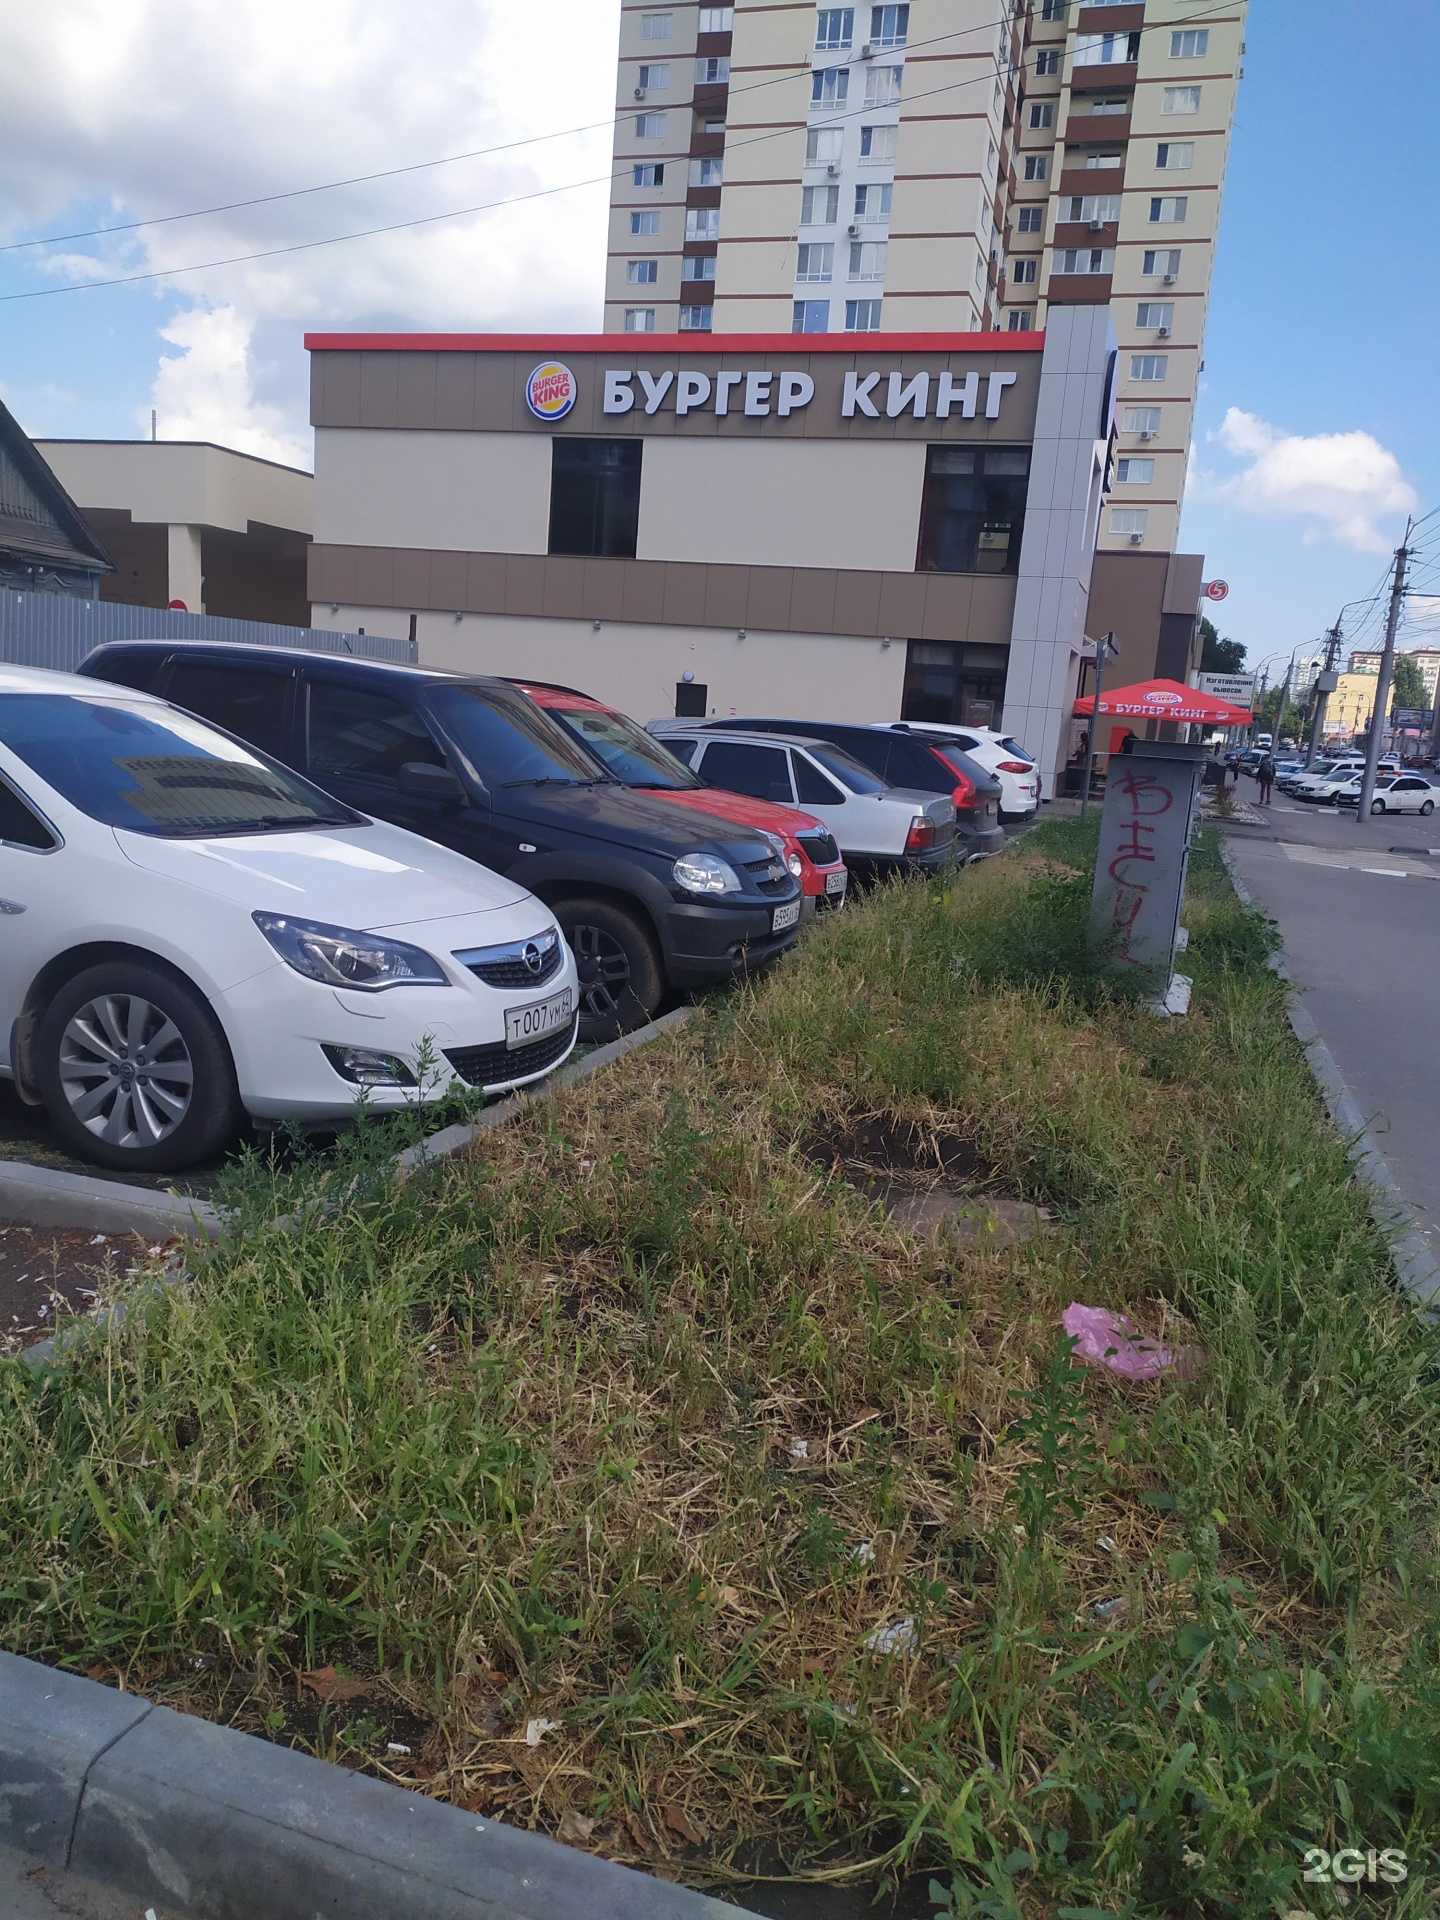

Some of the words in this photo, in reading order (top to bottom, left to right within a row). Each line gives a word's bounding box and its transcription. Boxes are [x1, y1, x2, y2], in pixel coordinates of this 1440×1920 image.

[532, 372, 569, 393] BURGER
[533, 382, 571, 406] KING
[603, 369, 815, 417] БУРГЕР
[841, 370, 1018, 420] КИНГ
[1115, 703, 1166, 715] БУРГЕР
[1170, 706, 1208, 719] КИНГ
